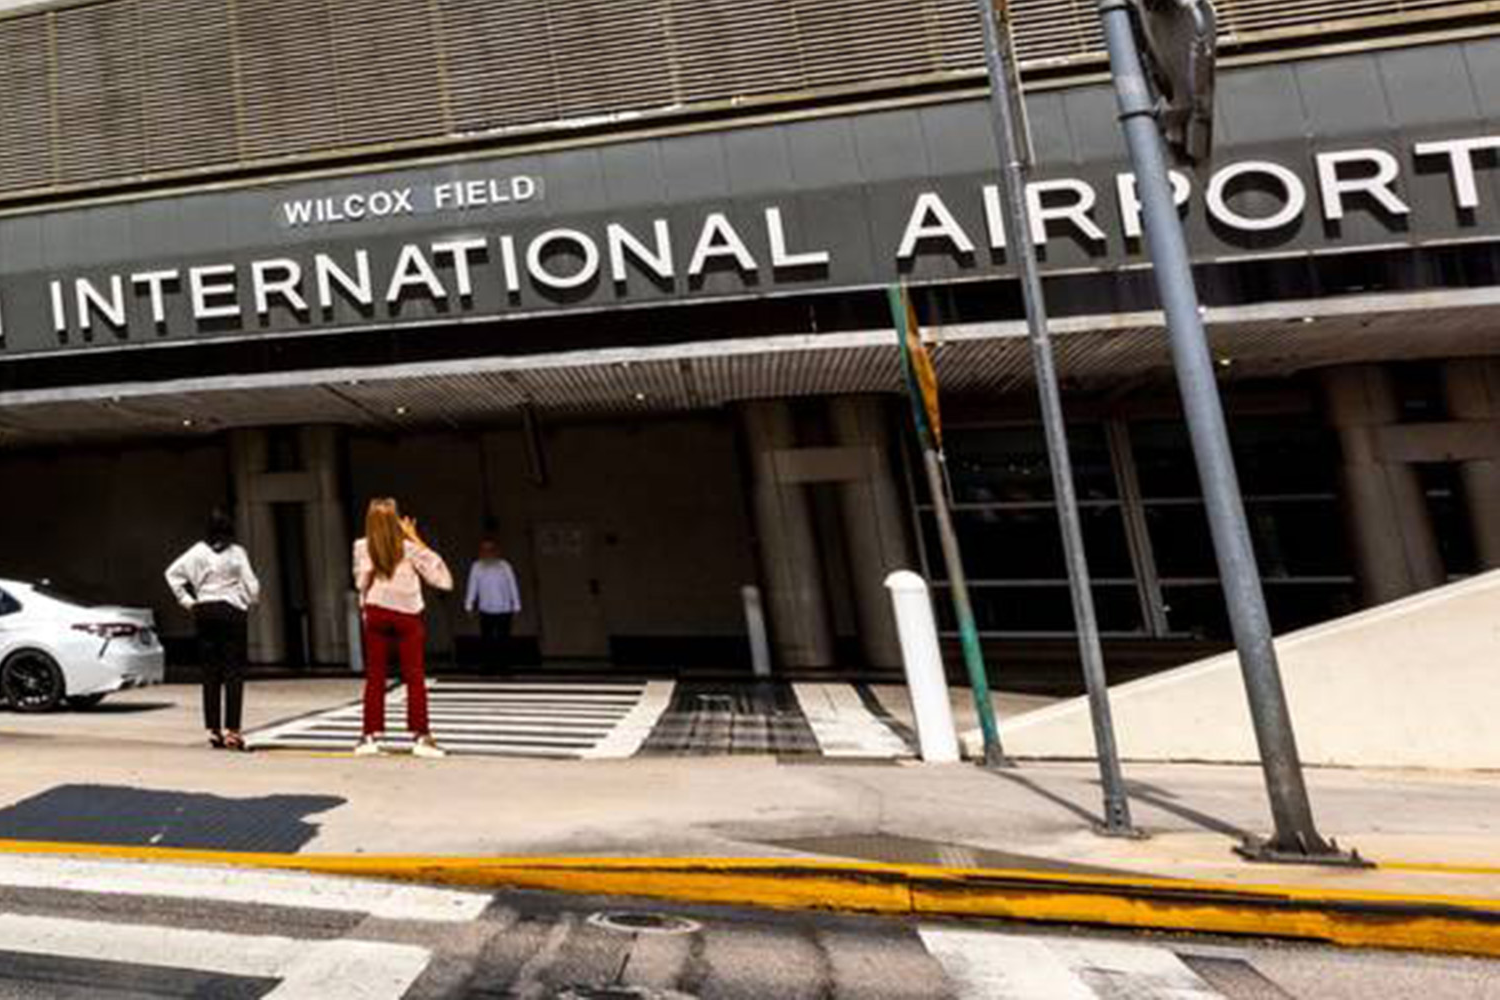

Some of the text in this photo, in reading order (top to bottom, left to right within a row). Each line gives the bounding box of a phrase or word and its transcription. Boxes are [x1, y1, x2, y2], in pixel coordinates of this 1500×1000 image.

[49, 207, 830, 334] INTERNATIONAL
[896, 136, 1500, 259] AIRPORT
[284, 175, 536, 225] WILCOX FIELD
